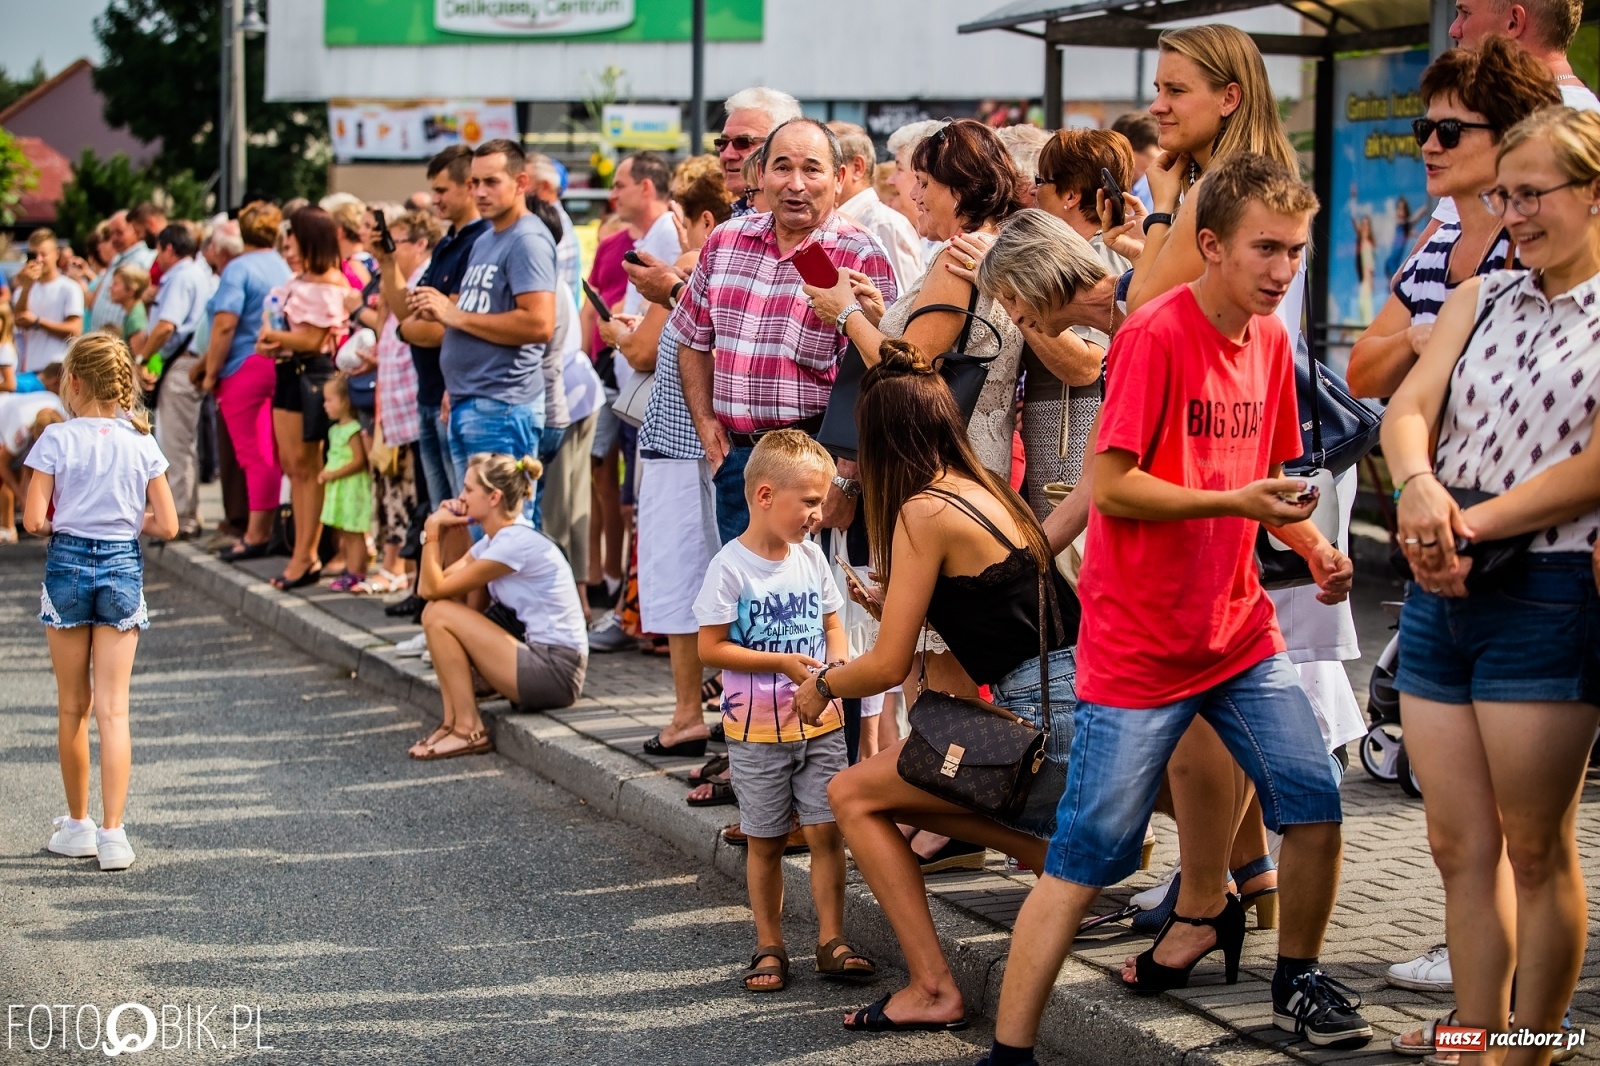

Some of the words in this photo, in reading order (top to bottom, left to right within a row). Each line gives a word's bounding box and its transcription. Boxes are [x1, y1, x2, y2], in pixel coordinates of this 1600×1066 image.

[1187, 398, 1226, 438] BIG
[749, 591, 819, 626] PALMS
[767, 624, 809, 637] CALIFORNIA
